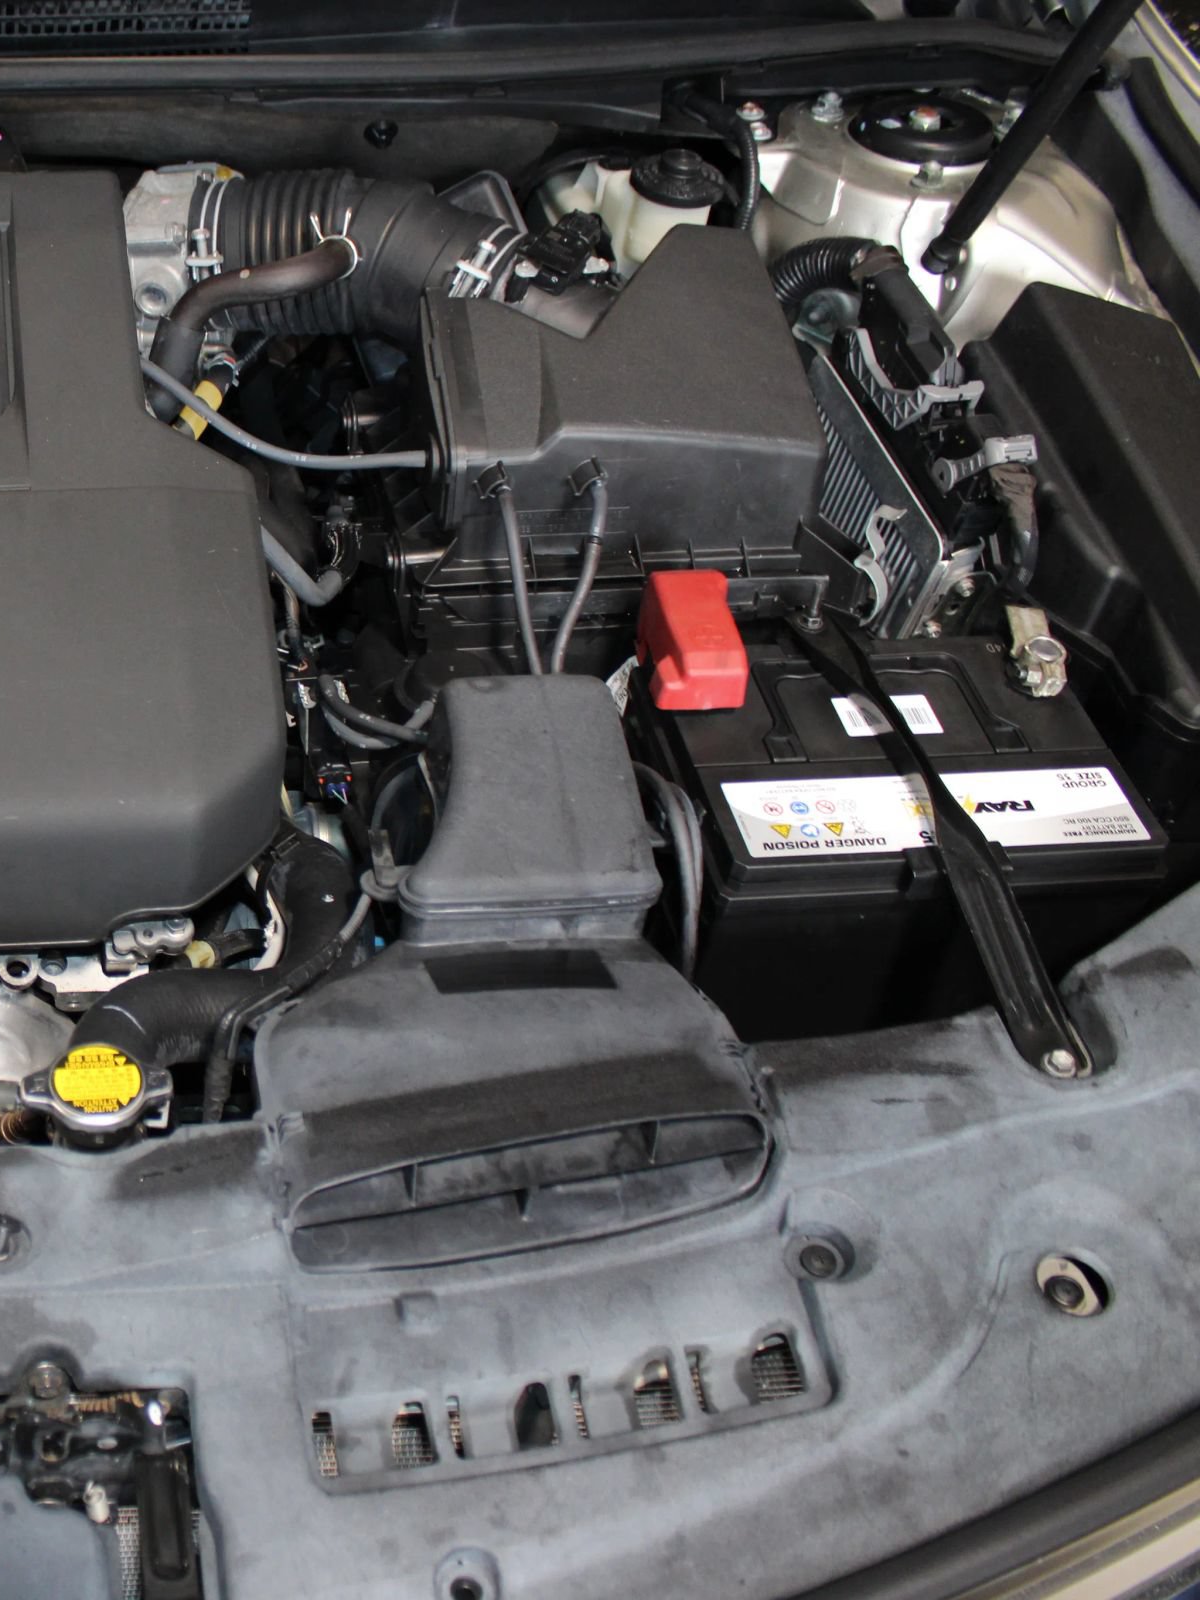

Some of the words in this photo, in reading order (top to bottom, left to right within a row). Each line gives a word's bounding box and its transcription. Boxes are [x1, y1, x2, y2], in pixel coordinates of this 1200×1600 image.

[1076, 772, 1103, 780] SIZE
[1062, 780, 1107, 788] GROUP
[974, 800, 1035, 814] RAY
[763, 840, 820, 851] POISON
[825, 837, 887, 848] DANGER
